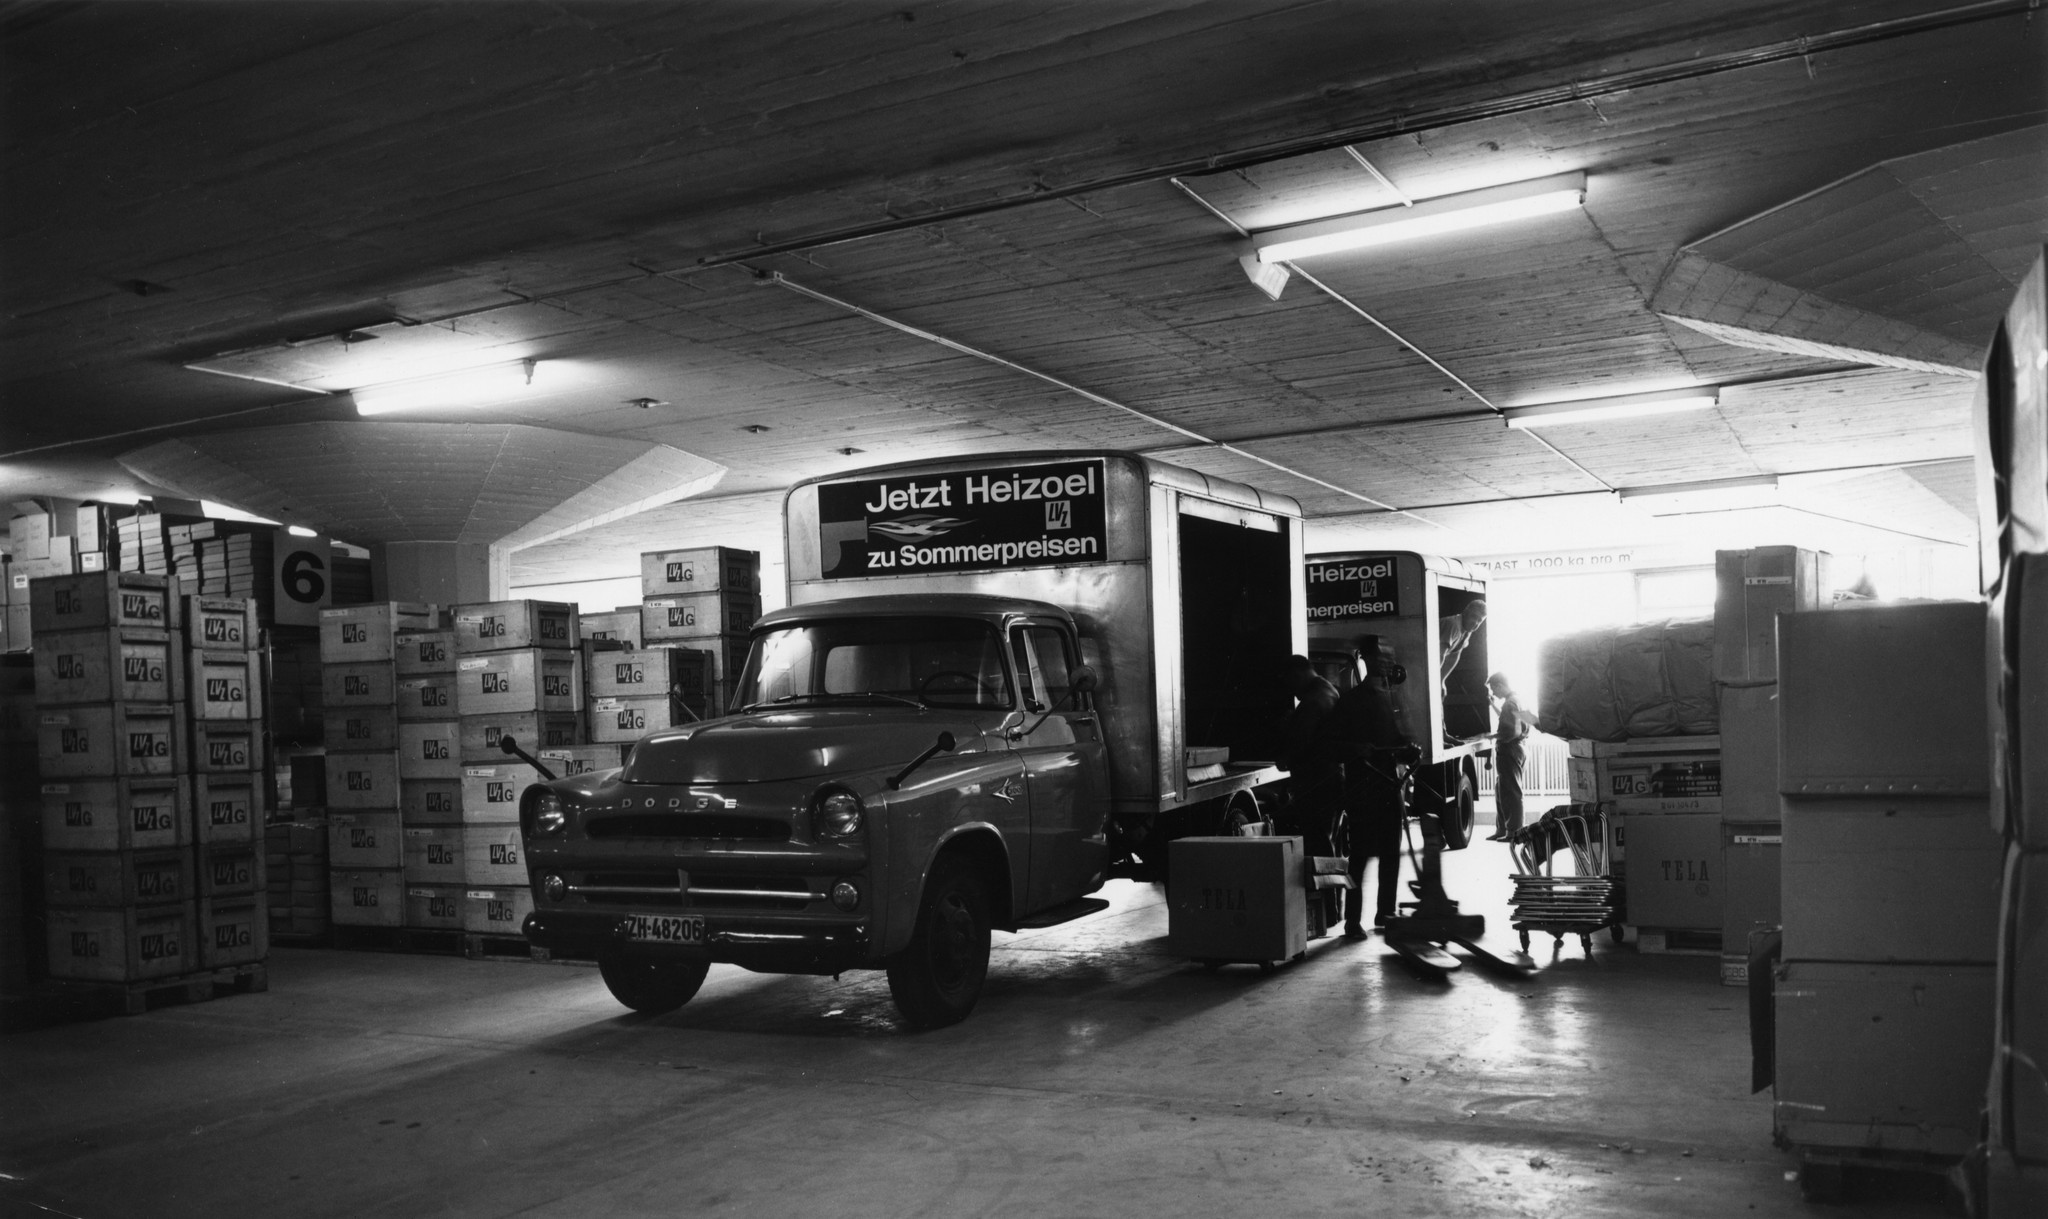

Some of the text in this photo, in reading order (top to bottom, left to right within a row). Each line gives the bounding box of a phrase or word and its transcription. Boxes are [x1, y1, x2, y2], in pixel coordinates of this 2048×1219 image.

[865, 466, 1095, 513] Jetzt Heizoel
[867, 534, 1097, 568] zu Sommerpreisen
[1528, 556, 1563, 569] 1000
[281, 550, 325, 604] 6
[1309, 560, 1392, 583] Heizoel
[622, 797, 738, 809] DODGE
[1661, 860, 1709, 881] TELA
[1202, 887, 1247, 911] TELA
